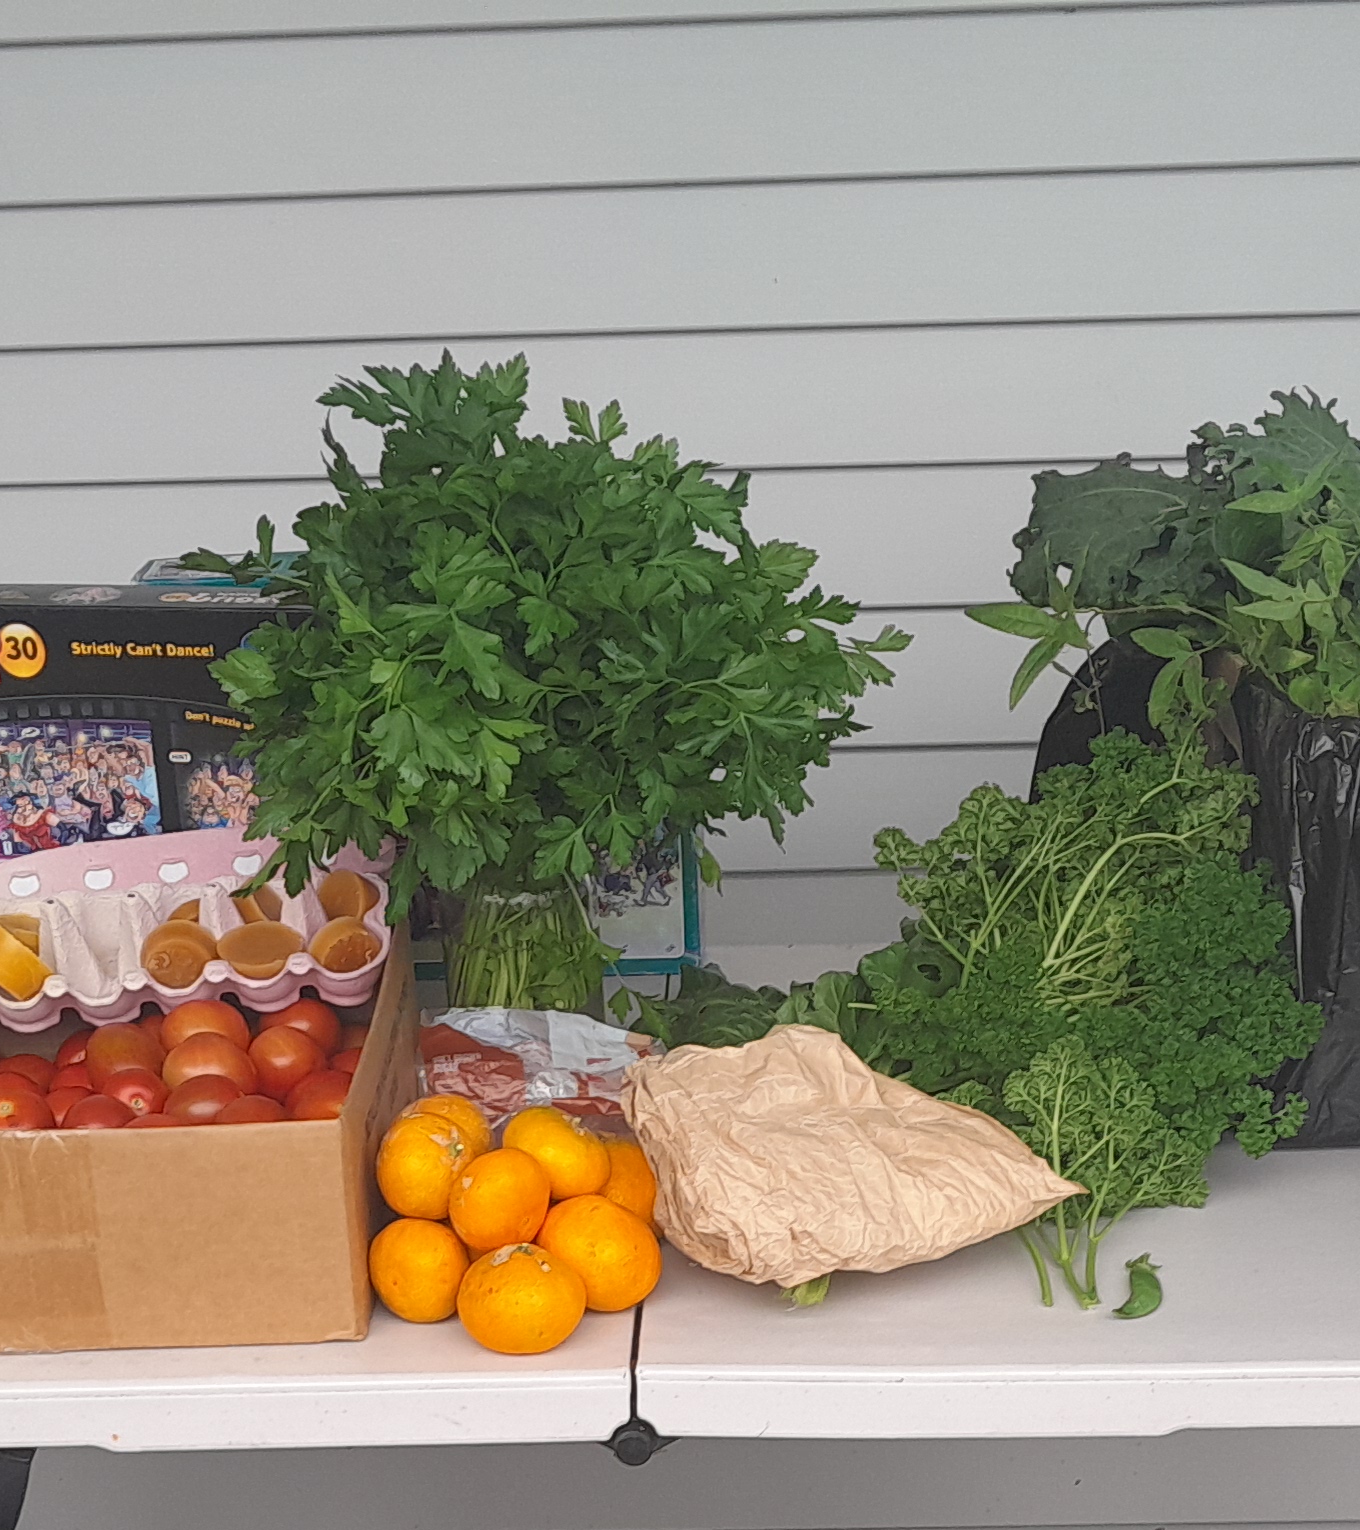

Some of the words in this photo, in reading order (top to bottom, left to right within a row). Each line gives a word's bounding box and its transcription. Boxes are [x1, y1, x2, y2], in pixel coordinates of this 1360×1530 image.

[4, 635, 38, 661] 30
[70, 641, 123, 659] Strictly
[125, 641, 164, 656] Can't
[165, 642, 215, 657] Dance!
[212, 715, 242, 729] puzzle
